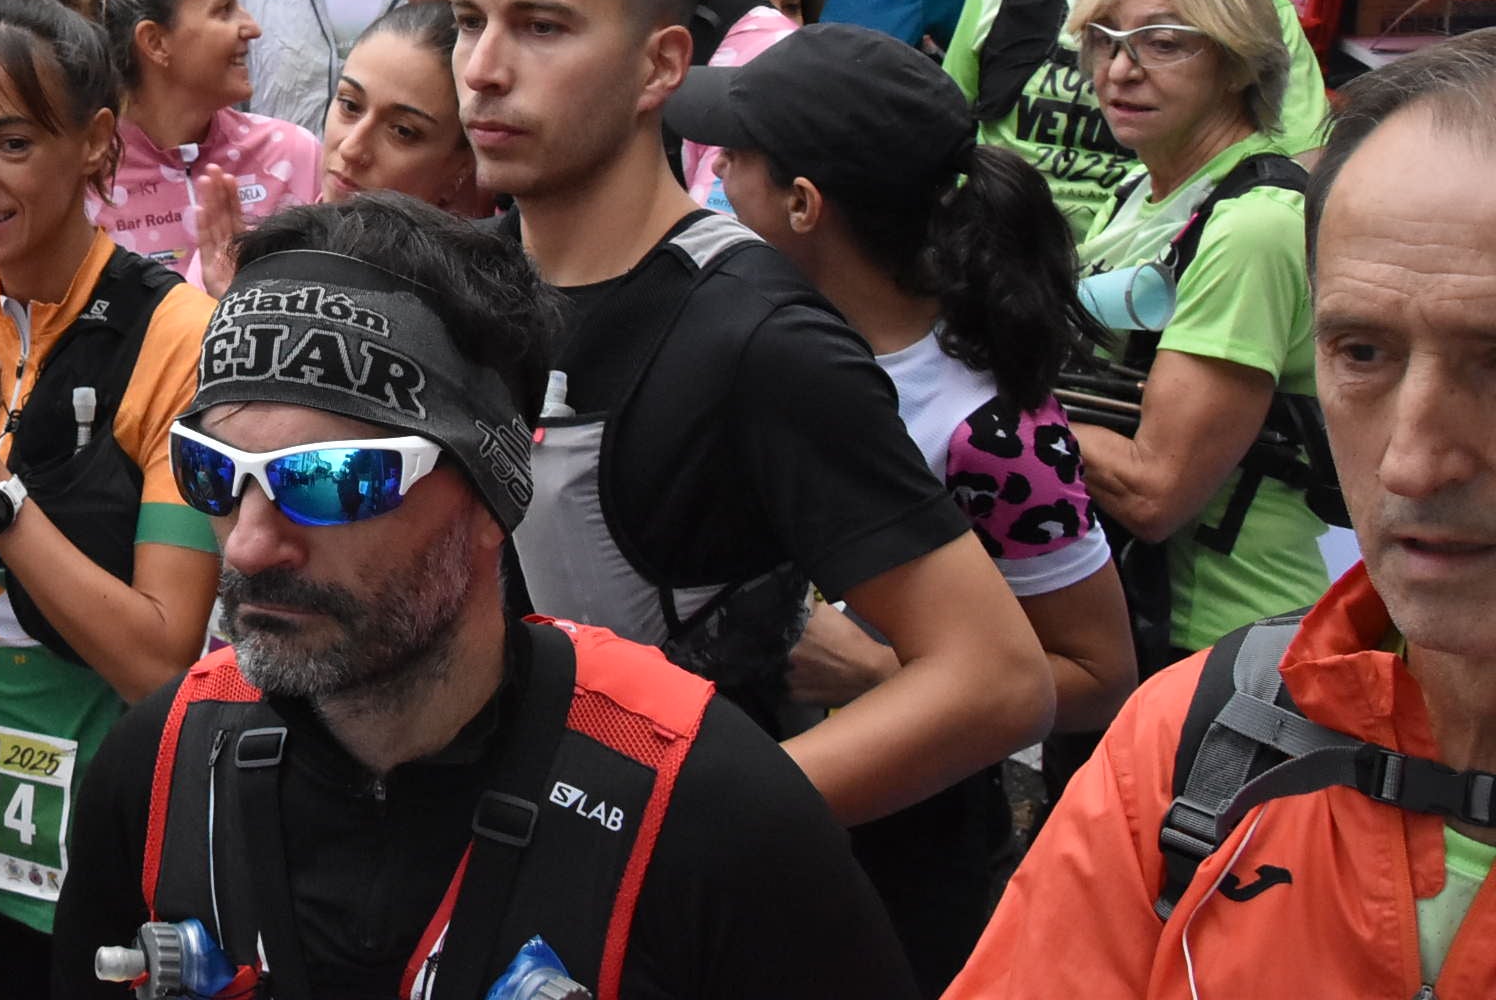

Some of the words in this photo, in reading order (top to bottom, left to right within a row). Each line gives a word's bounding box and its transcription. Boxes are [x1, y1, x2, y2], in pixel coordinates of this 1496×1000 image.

[239, 184, 262, 201] DELA
[115, 218, 142, 233] Bar
[145, 209, 183, 227] Roda
[198, 317, 427, 420] ÉJAR
[4, 743, 61, 777] 2025
